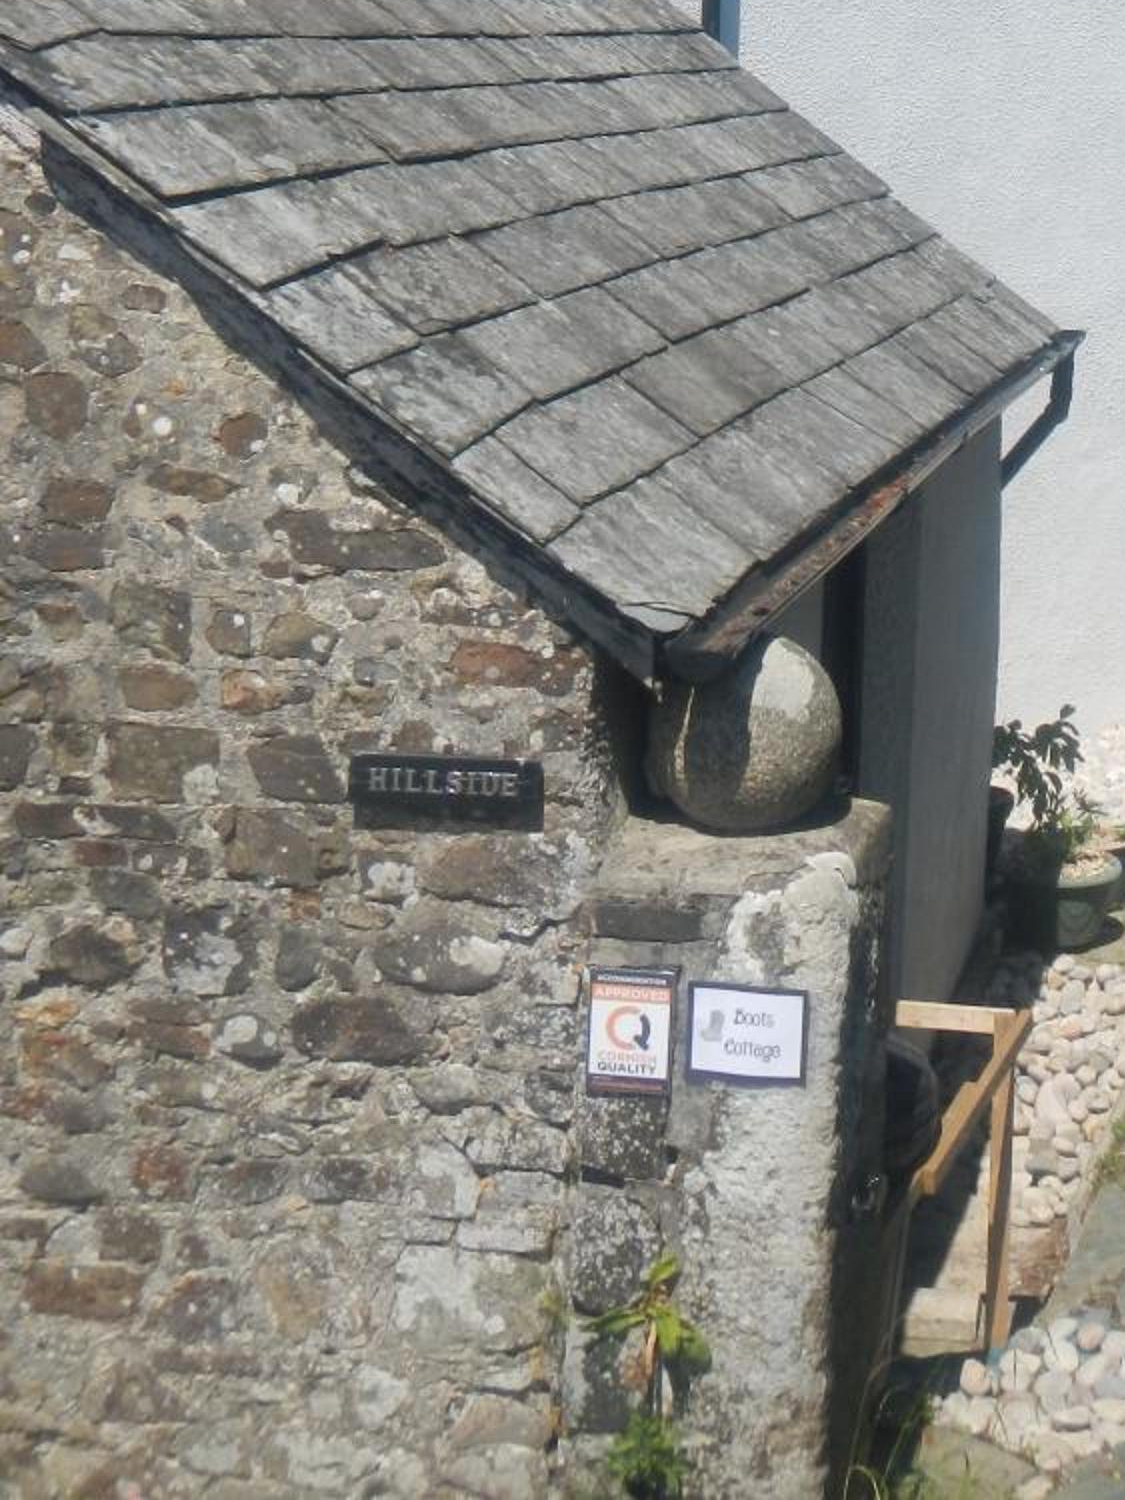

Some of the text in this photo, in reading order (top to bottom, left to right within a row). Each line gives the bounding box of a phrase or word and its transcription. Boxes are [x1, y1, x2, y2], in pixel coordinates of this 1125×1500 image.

[368, 767, 519, 796] HILLSIDE
[595, 986, 669, 1001] APPROVED
[724, 1037, 781, 1062] Cottage
[597, 1061, 657, 1075] QUALITY
